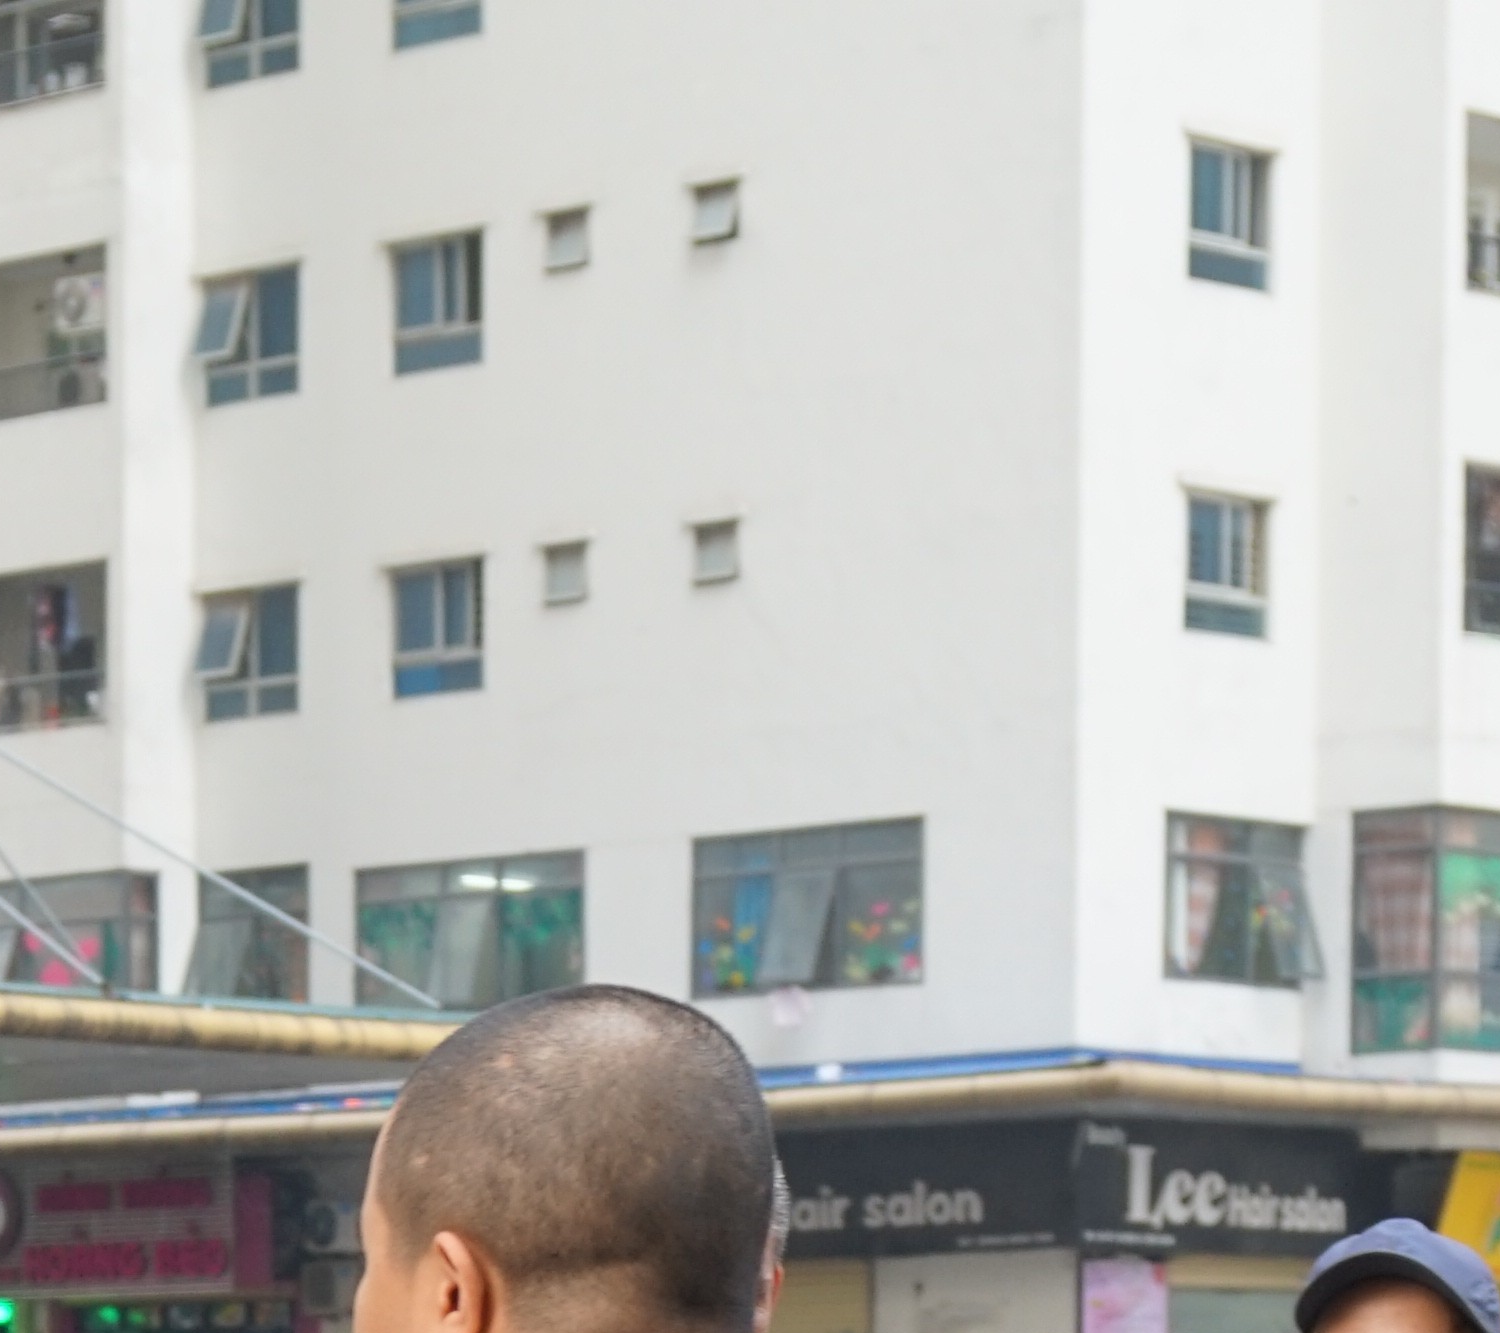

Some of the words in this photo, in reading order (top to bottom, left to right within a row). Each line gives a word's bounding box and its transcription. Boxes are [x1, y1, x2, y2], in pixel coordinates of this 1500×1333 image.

[790, 1184, 850, 1231] air
[862, 1178, 985, 1229] salon
[1125, 1143, 1228, 1230] Lee
